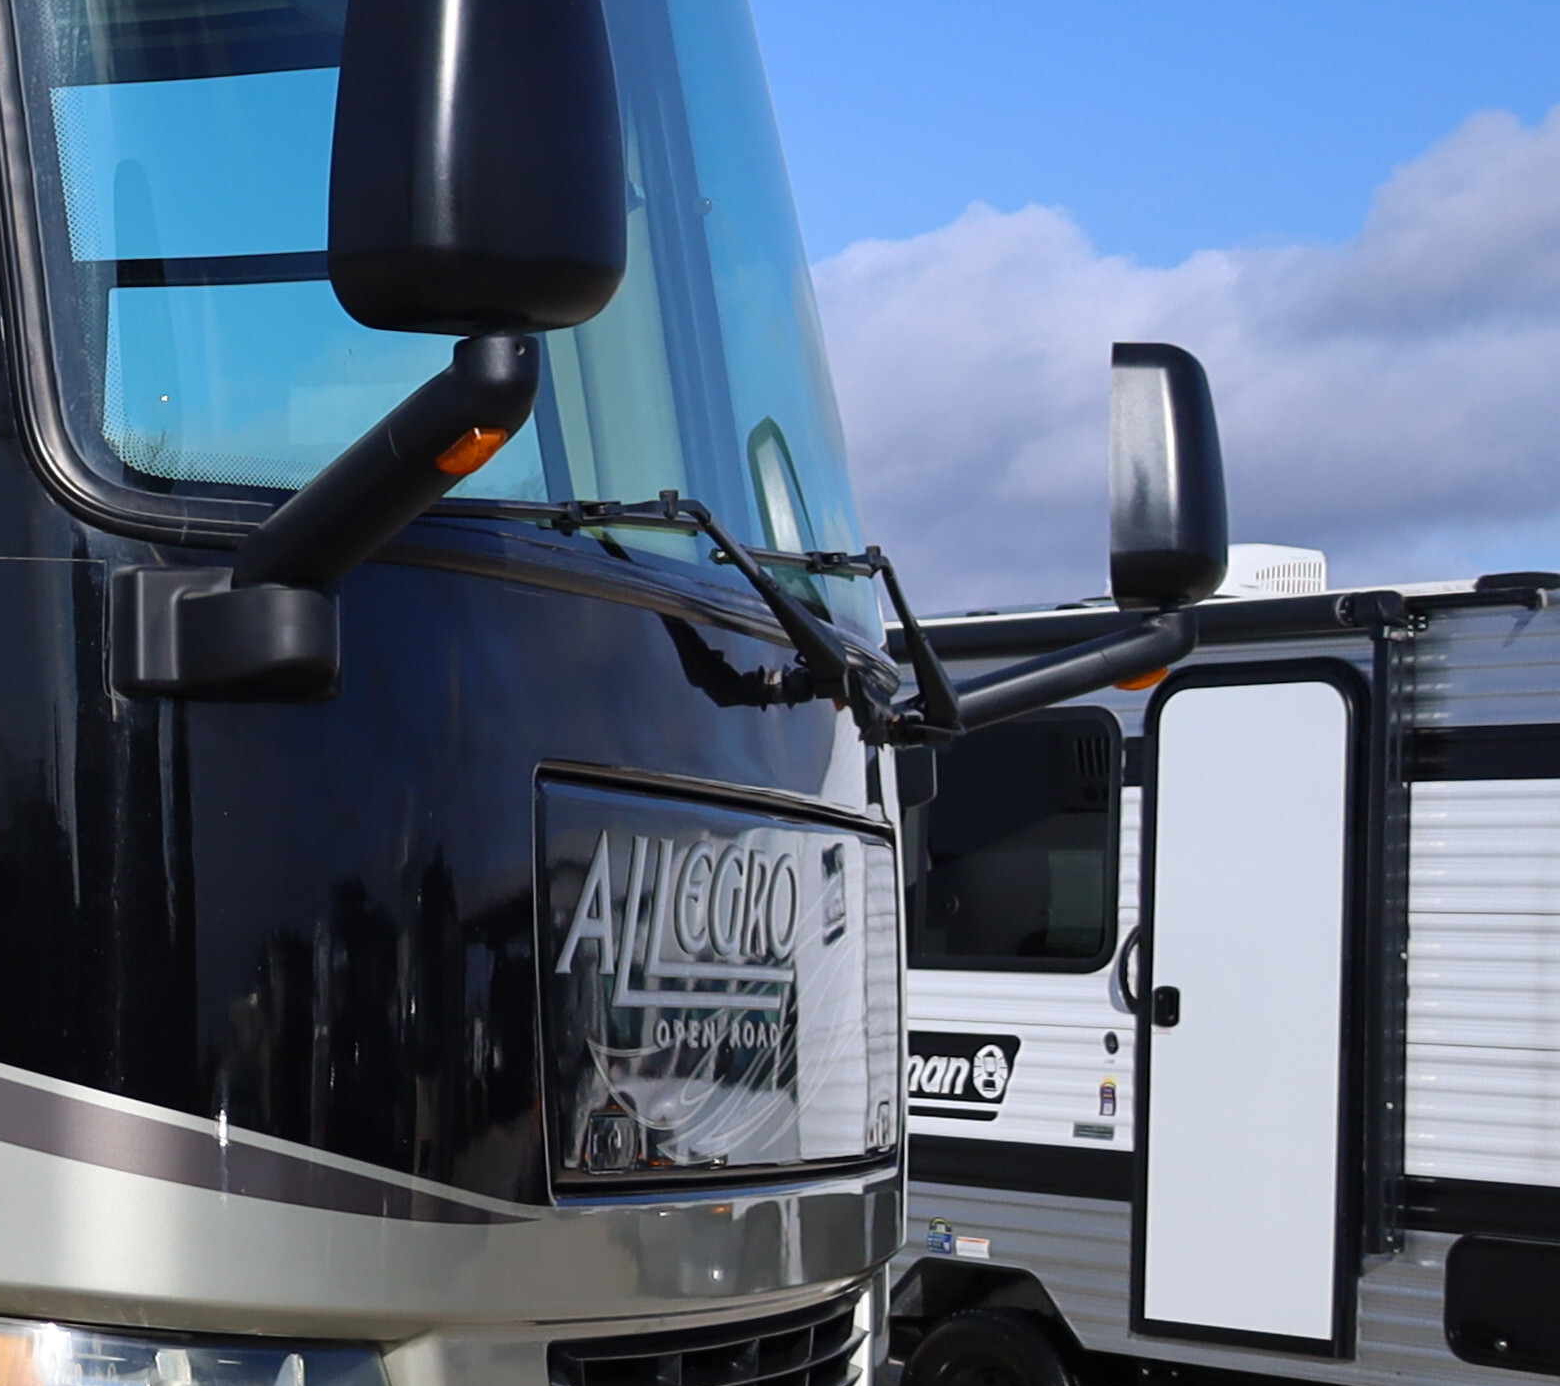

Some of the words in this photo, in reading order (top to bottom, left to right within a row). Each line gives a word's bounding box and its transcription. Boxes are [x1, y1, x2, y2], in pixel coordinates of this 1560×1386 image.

[554, 829, 800, 1009] ALLEGRO
[654, 1018, 718, 1050] OPEN
[729, 1020, 783, 1050] ROAD
